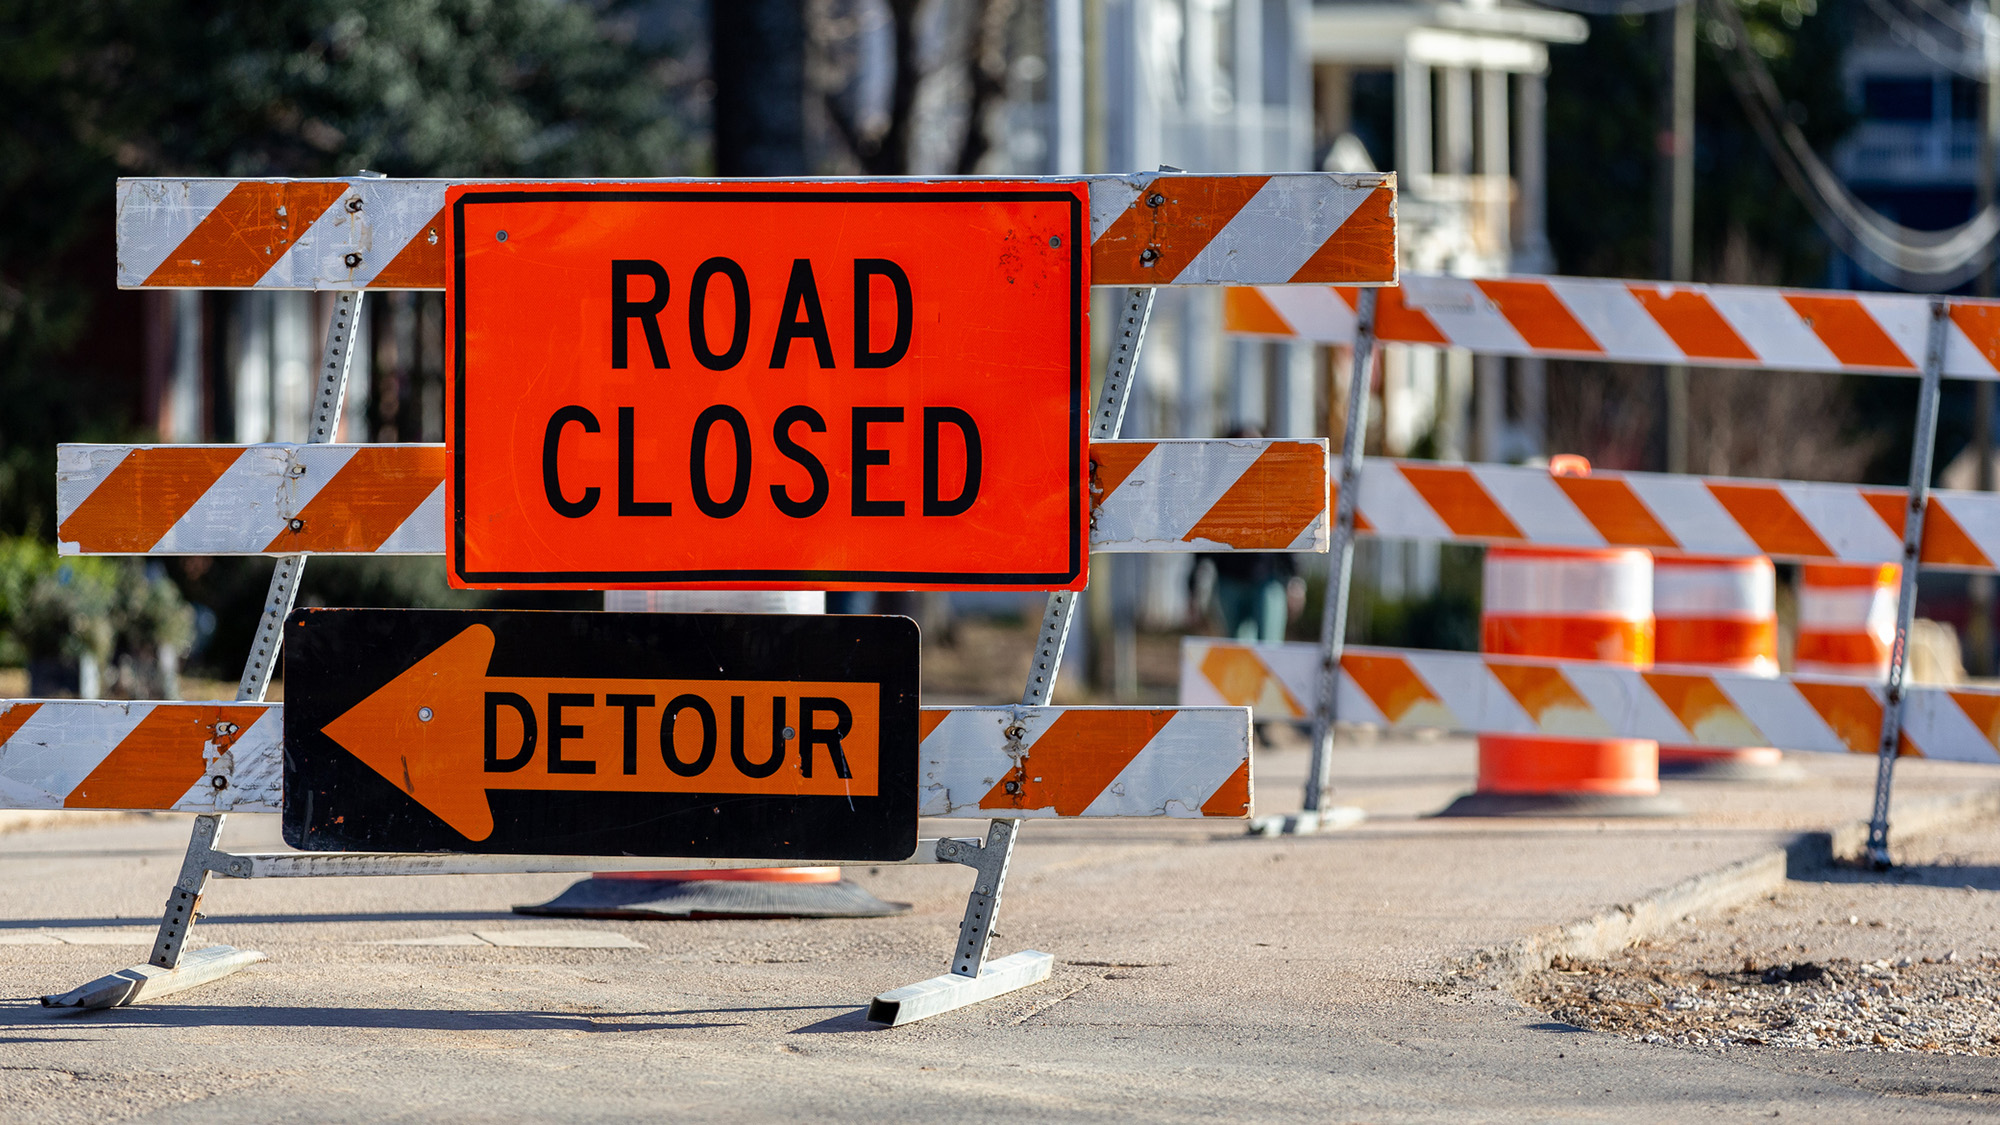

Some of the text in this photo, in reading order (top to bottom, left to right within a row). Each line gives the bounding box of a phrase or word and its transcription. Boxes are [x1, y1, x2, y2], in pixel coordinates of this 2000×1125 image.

[611, 256, 914, 372] ROAD
[542, 404, 983, 519] CLOSED
[483, 691, 853, 780] DETOUR
